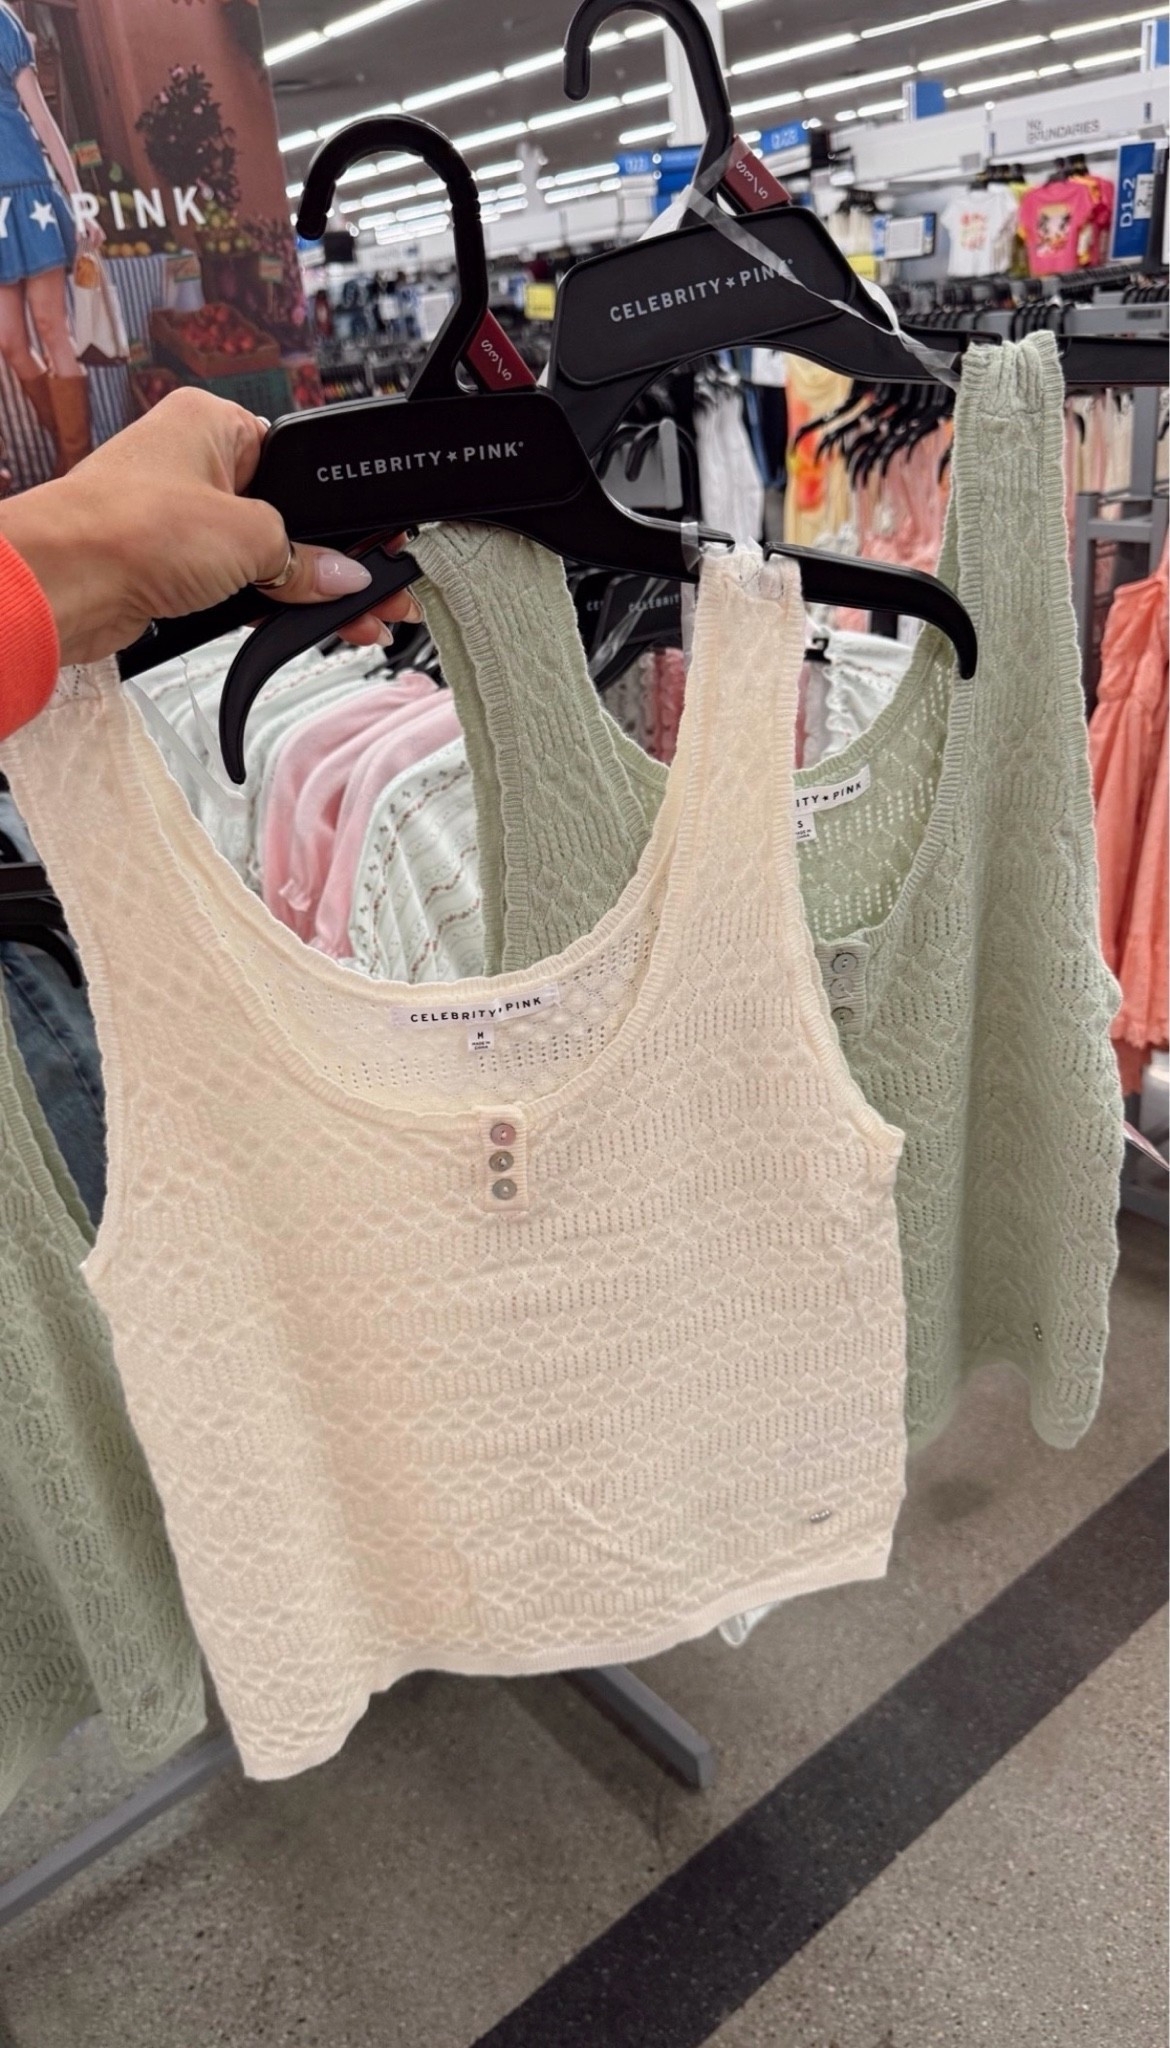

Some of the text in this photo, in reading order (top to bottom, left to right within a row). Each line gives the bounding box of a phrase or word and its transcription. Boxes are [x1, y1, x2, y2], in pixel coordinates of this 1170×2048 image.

[1027, 119, 1099, 144] BOUNDARIES
[71, 186, 206, 239] PINK
[1120, 178, 1135, 227] D1-2
[610, 278, 720, 322] CELEBRITY
[316, 441, 518, 482] CELEBRITY PINK
[833, 782, 861, 800] PINK
[797, 820, 804, 829] S
[410, 997, 541, 1022] CELEBRITY PINK
[477, 1031, 484, 1040] M
